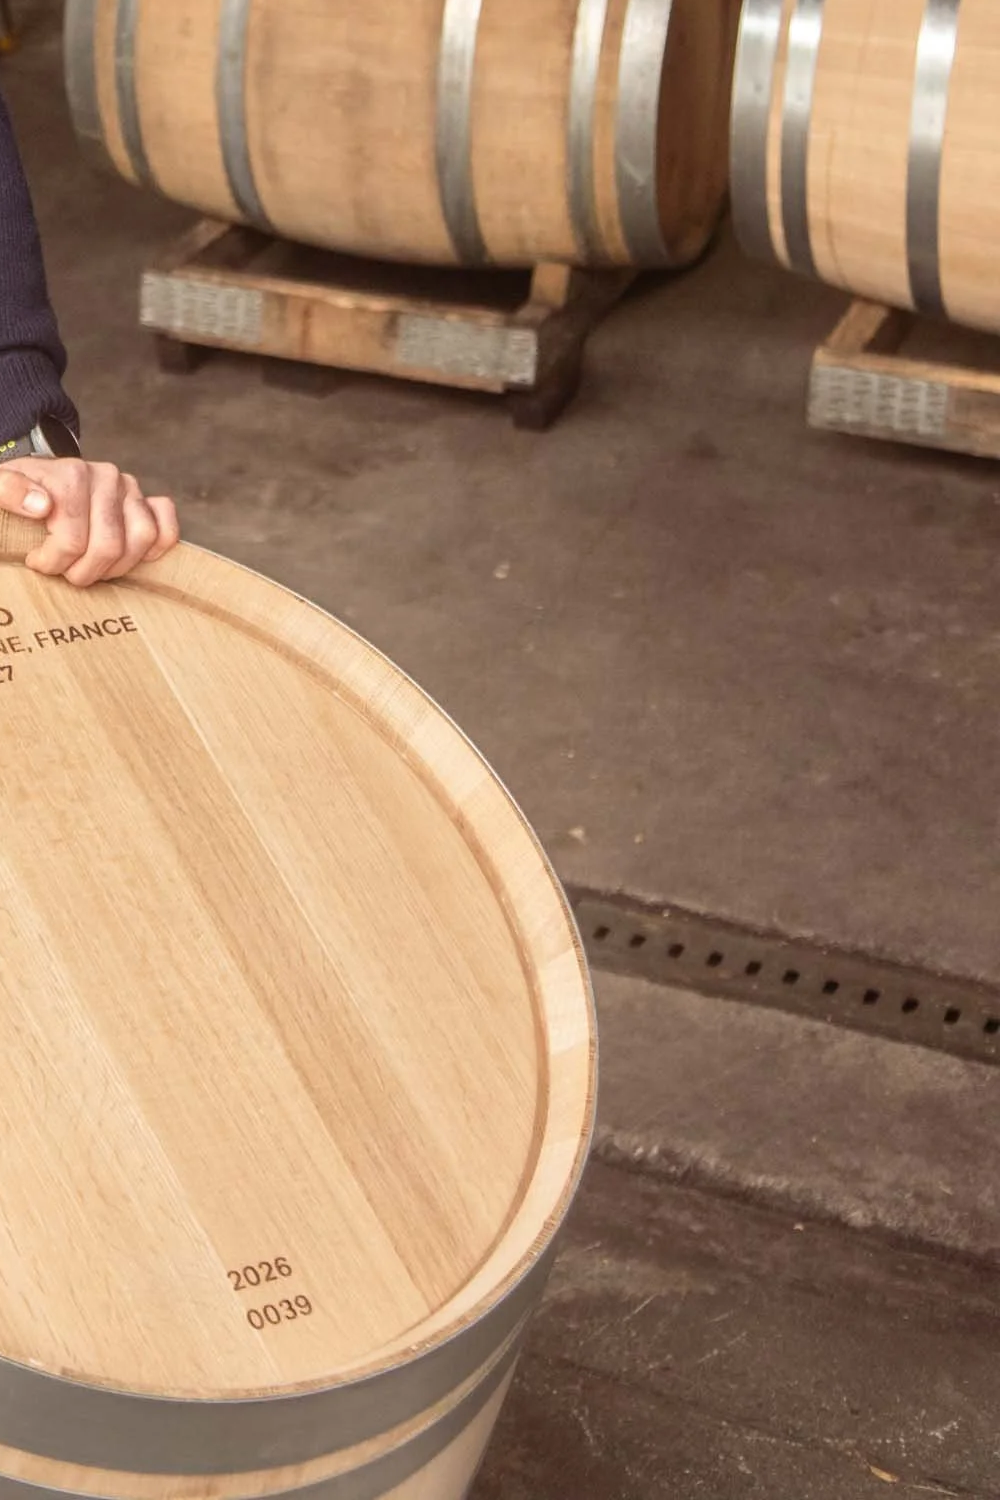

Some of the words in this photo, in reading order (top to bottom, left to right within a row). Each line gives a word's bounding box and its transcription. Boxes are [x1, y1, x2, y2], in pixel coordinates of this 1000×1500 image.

[33, 615, 138, 649] FRANCE
[227, 1256, 293, 1292] 2026
[246, 1294, 313, 1330] 0039
